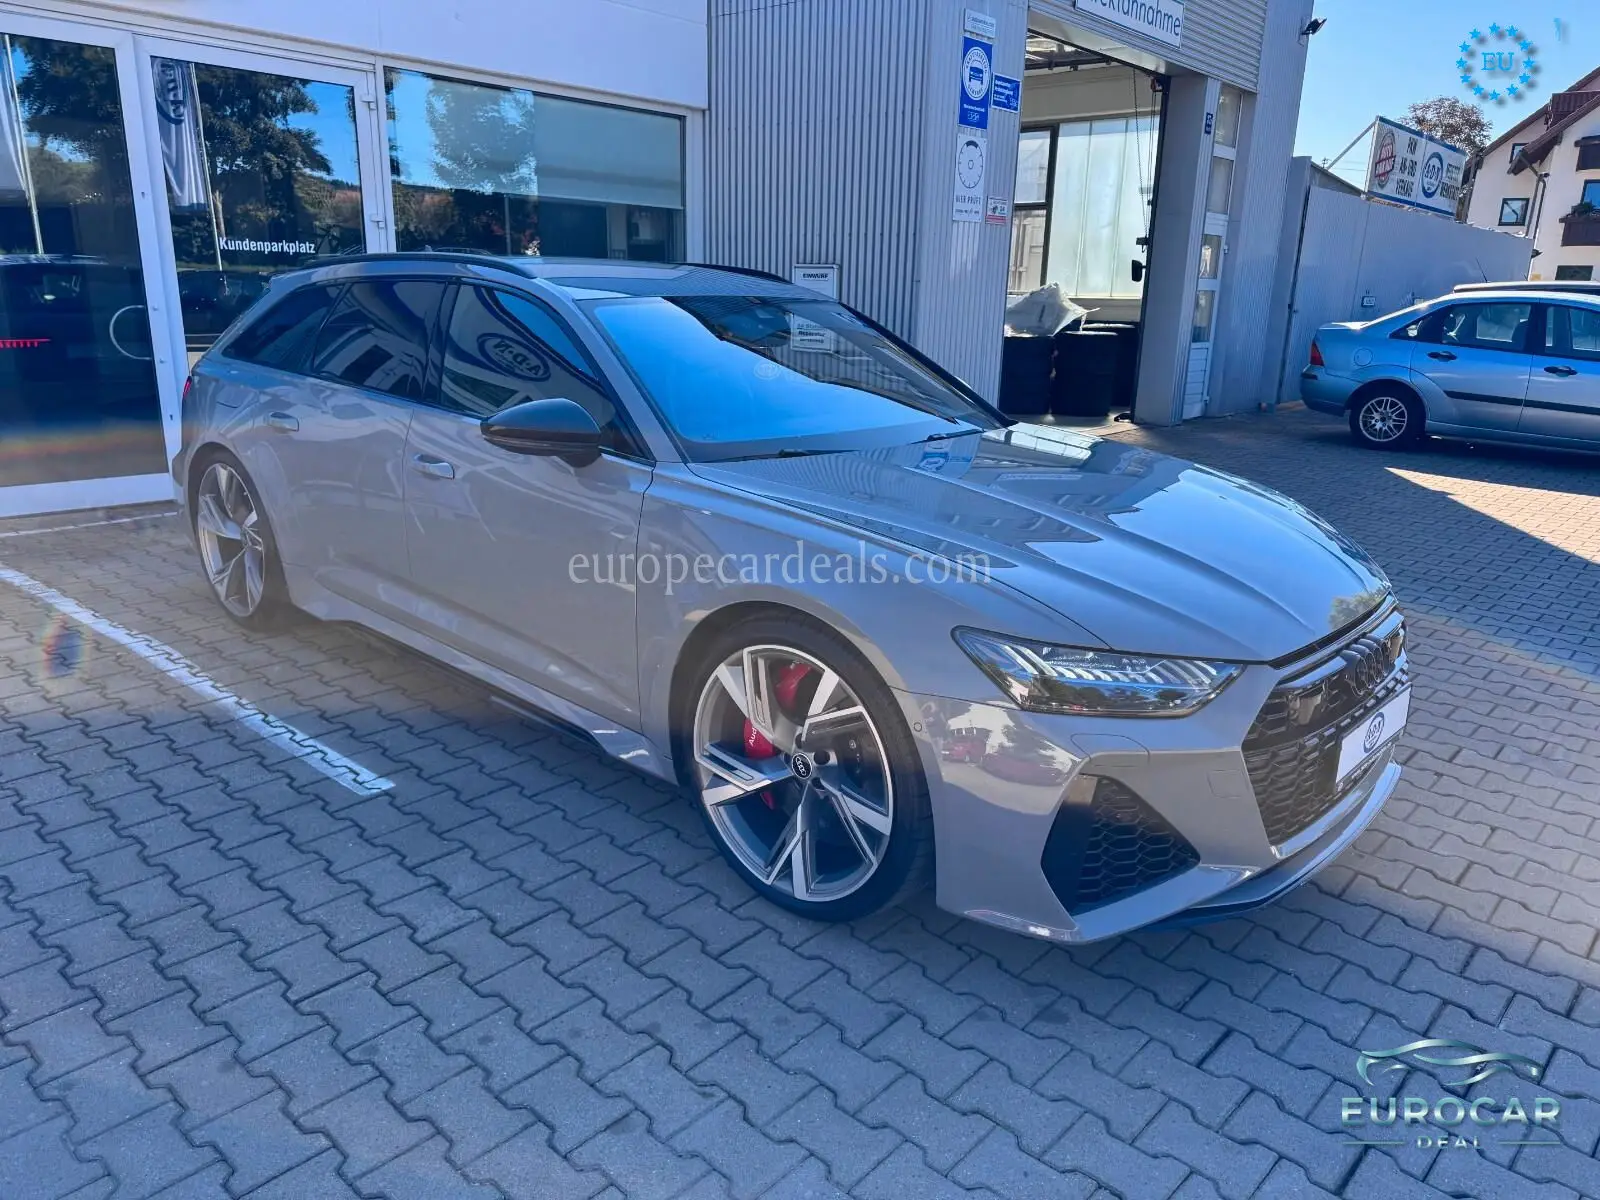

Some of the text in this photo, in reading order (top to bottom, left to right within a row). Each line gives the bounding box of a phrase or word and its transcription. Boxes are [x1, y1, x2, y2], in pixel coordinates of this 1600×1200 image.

[1093, 0, 1181, 37] tannahme
[219, 237, 316, 256] Kundenparkplatz
[748, 726, 757, 748] Aud
